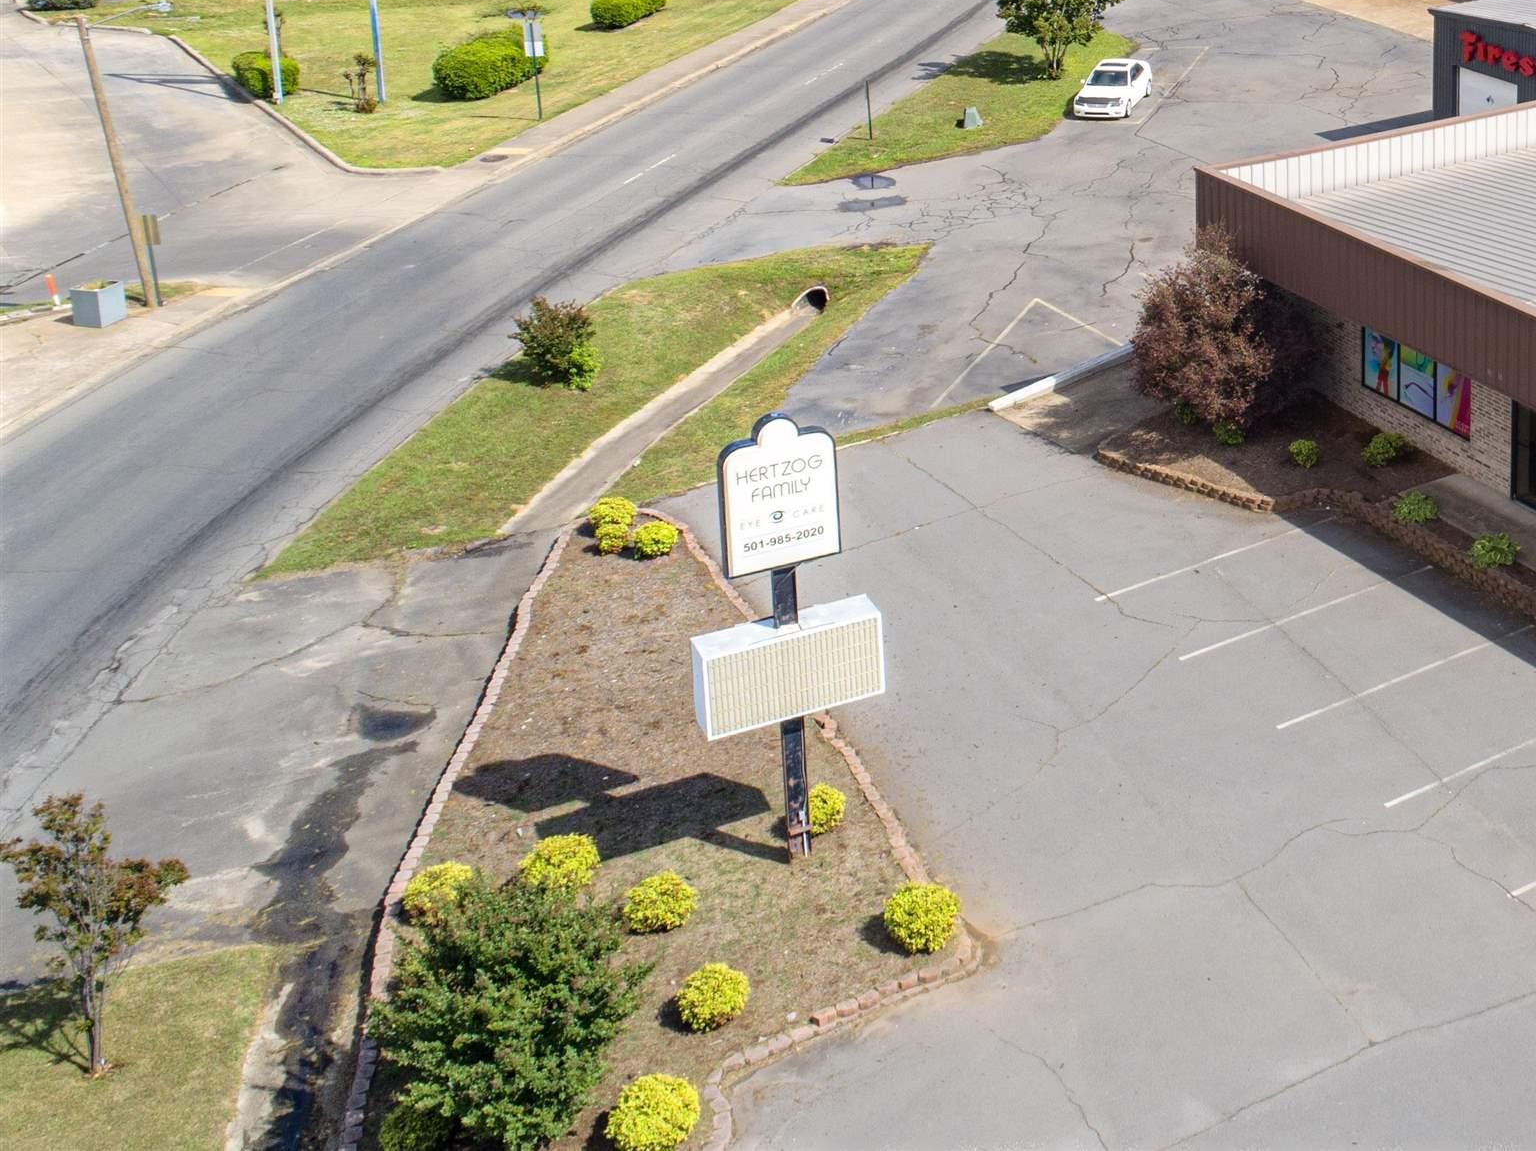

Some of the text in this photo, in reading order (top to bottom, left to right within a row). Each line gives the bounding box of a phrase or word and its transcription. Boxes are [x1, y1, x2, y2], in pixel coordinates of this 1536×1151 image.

[736, 454, 824, 486] HERTZOG
[751, 477, 812, 503] FAMILY
[739, 504, 825, 531] EYE CARE
[743, 525, 825, 553] 501-985-2020
